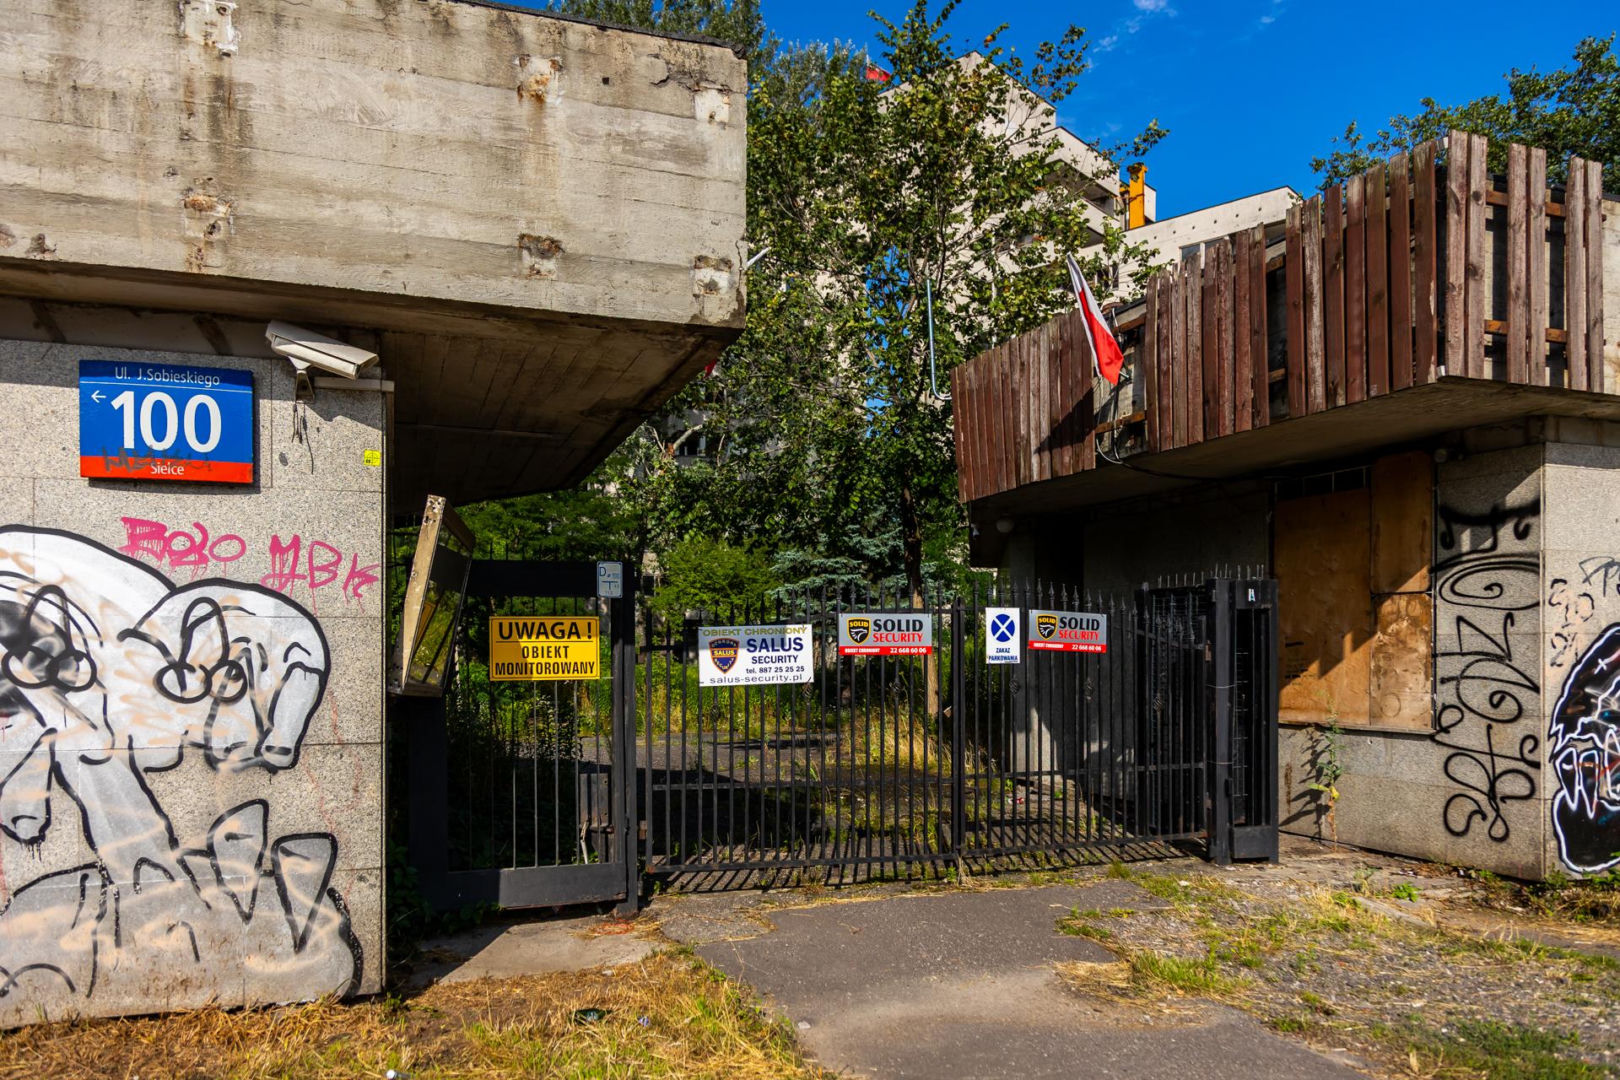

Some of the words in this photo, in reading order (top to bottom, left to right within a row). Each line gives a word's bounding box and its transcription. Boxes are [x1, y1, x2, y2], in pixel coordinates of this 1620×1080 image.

[115, 367, 131, 380] Ul.
[137, 368, 220, 387] J.Sobieskiego
[110, 390, 222, 453] 100
[498, 621, 581, 640] UWAGA
[587, 621, 592, 640] !
[872, 618, 924, 632] SOLID
[1059, 616, 1100, 631] SOLID
[702, 628, 742, 637] OBIEKT
[744, 626, 807, 636] CHRONIONY
[872, 632, 924, 643] SECURITY
[1058, 629, 1099, 641] SECURITY
[746, 636, 804, 653] SALUS
[521, 645, 570, 659] OBIEKT
[751, 654, 799, 664] SECURITY
[495, 661, 595, 676] MONITOROWANY
[709, 673, 803, 684] salus-security.pl
